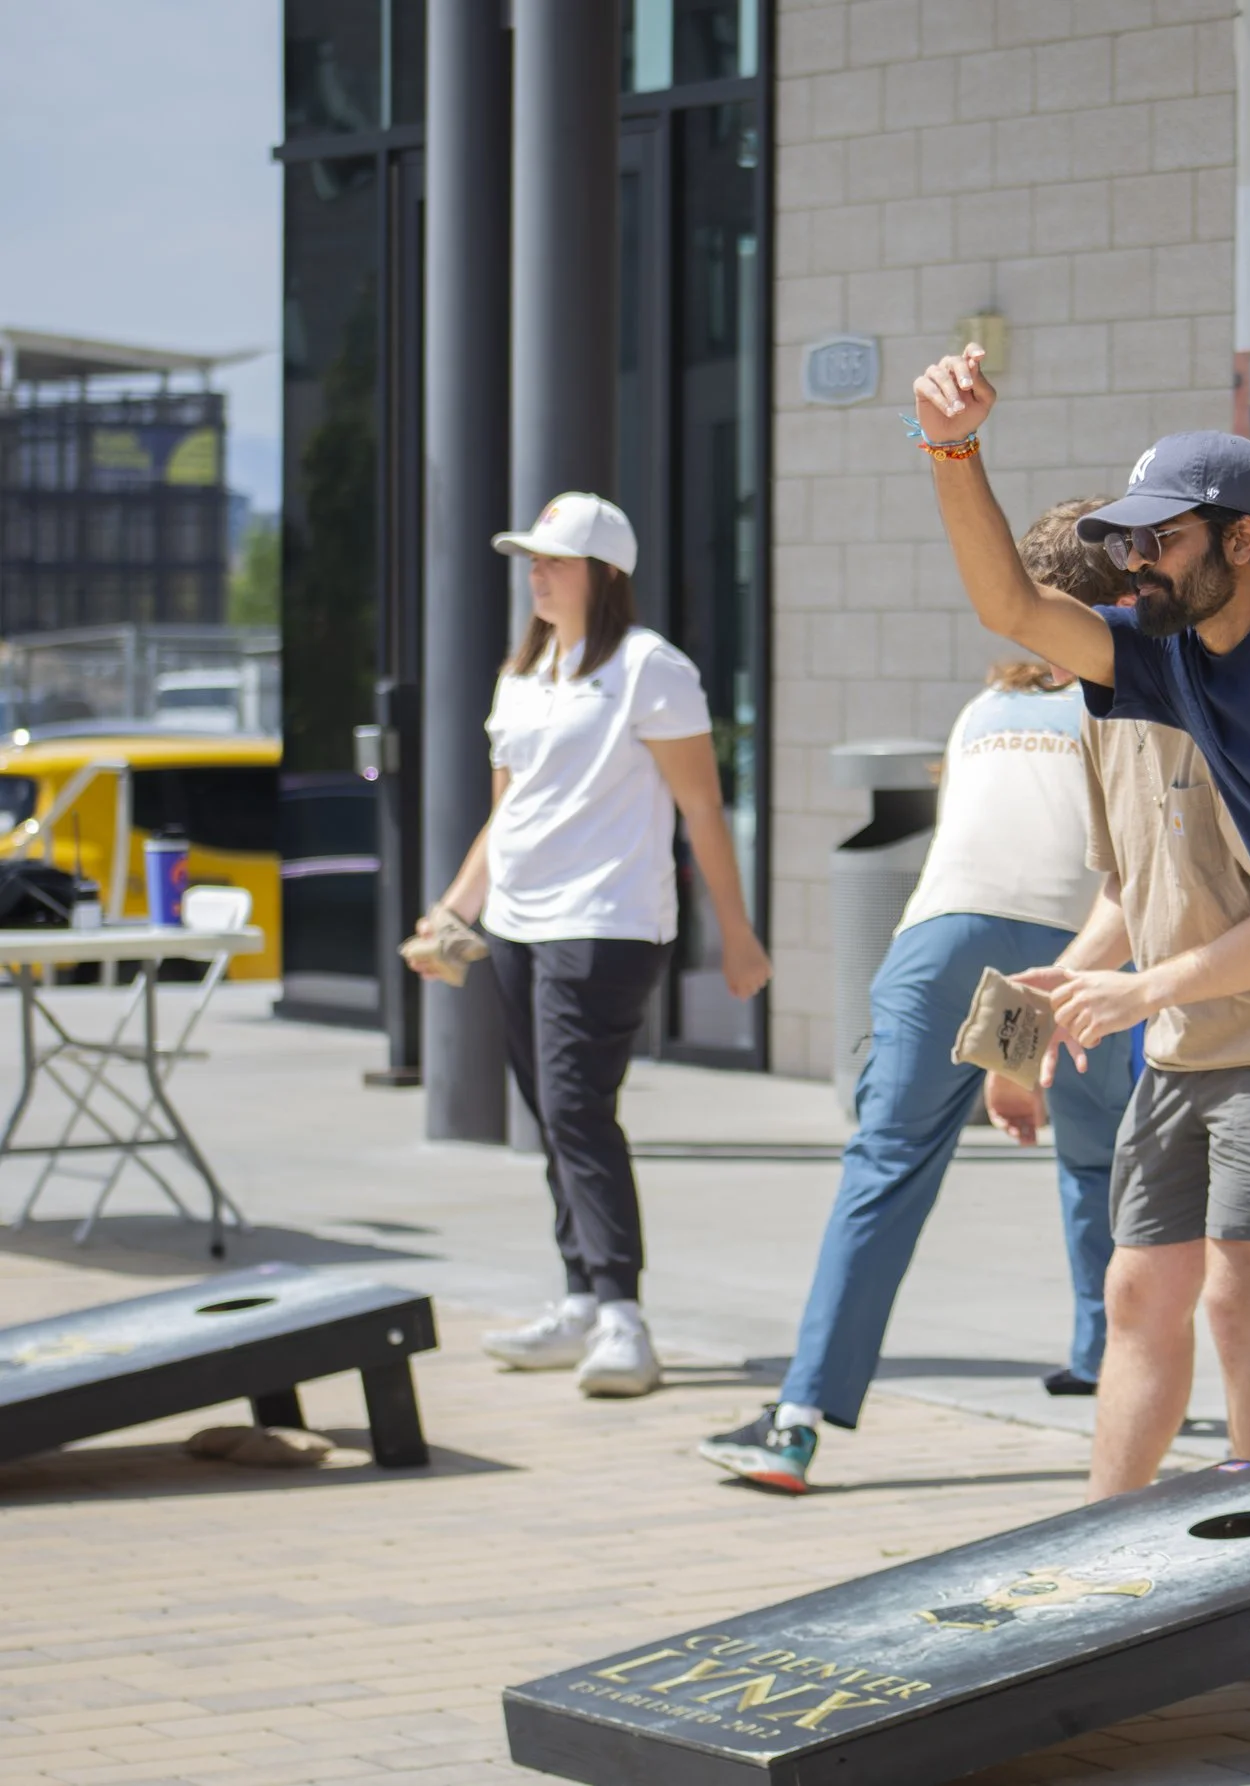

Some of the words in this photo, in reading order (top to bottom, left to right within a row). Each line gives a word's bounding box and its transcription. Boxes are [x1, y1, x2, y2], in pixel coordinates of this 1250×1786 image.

[588, 1648, 891, 1731] LYNX
[684, 1634, 760, 1656] CU
[748, 1649, 932, 1700] DENVER
[567, 1680, 723, 1724] ESTABLISHED
[721, 1719, 782, 1740] 2012
